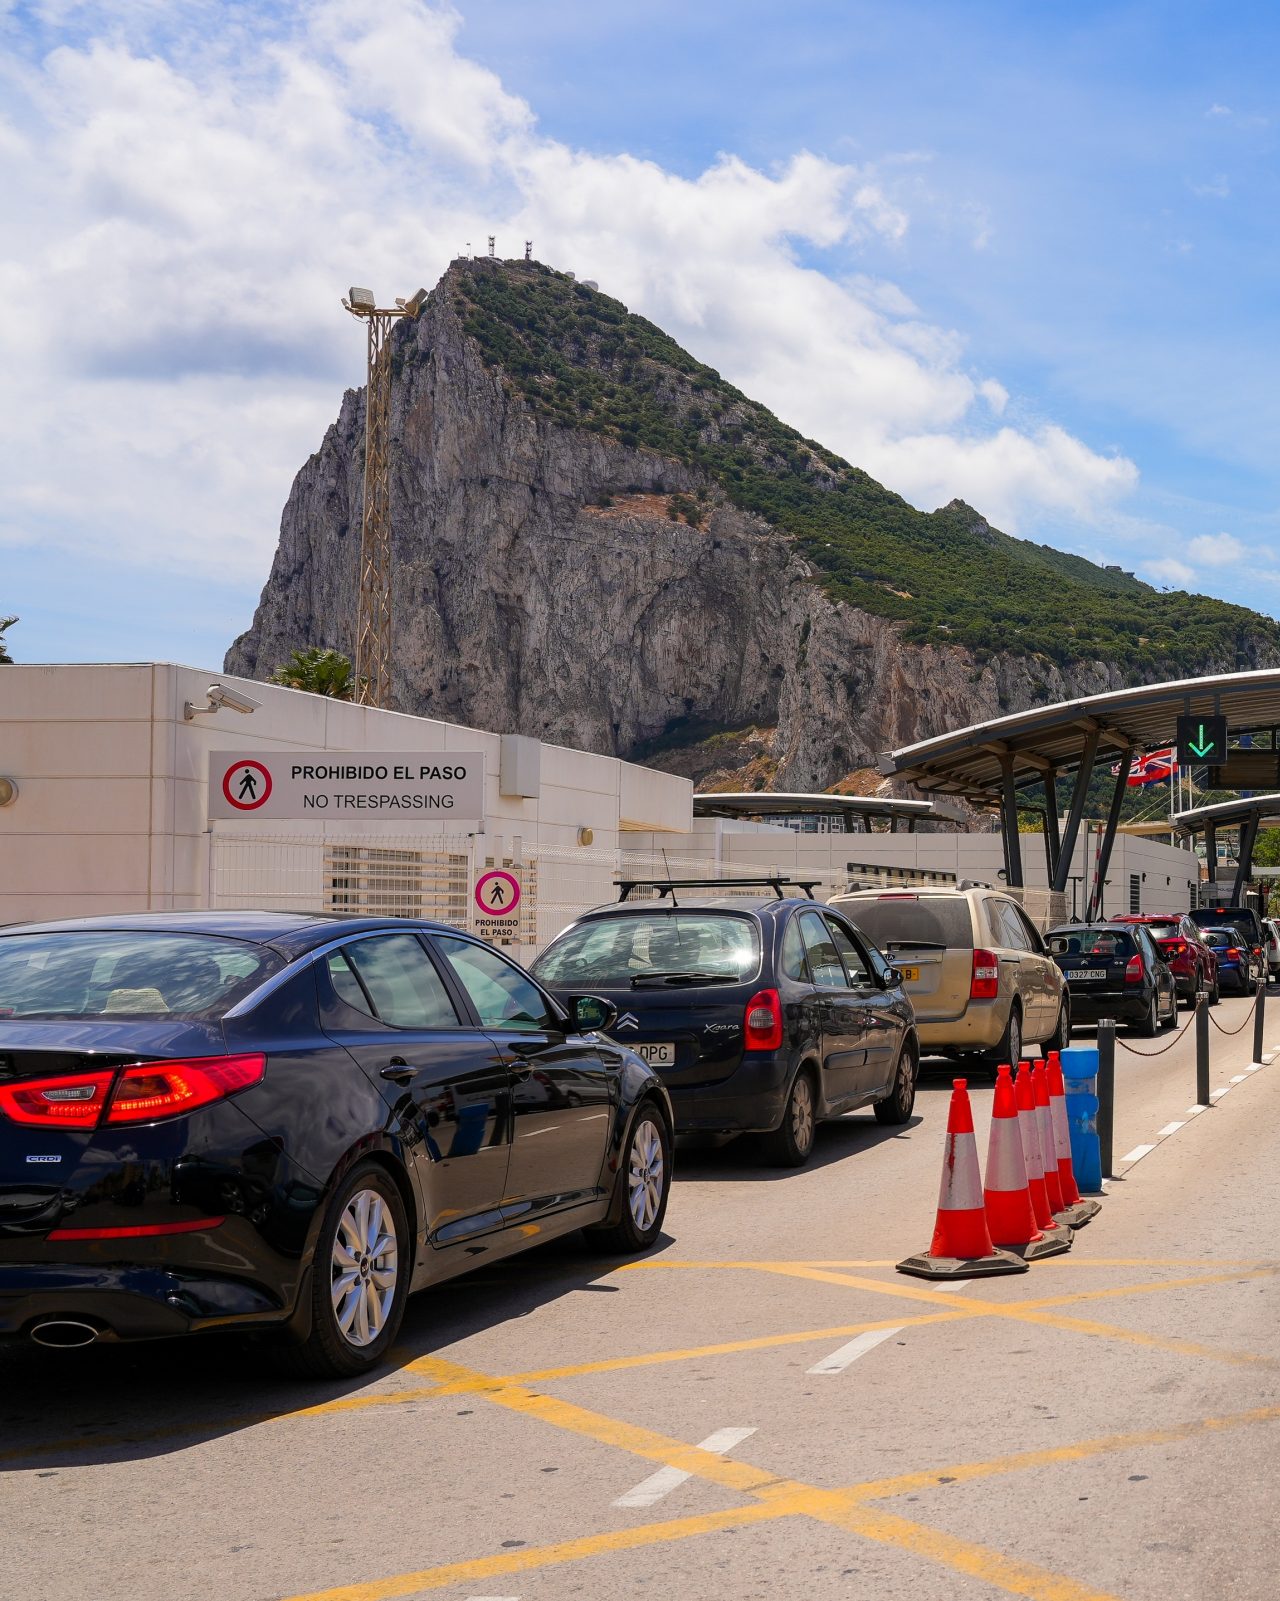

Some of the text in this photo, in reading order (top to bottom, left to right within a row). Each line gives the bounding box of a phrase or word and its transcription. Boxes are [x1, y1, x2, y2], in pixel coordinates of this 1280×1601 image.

[291, 766, 467, 780] PROHIBIDO EL PASO
[303, 794, 454, 809] NO TRESPASSING
[1069, 970, 1105, 979] 0327 CNG
